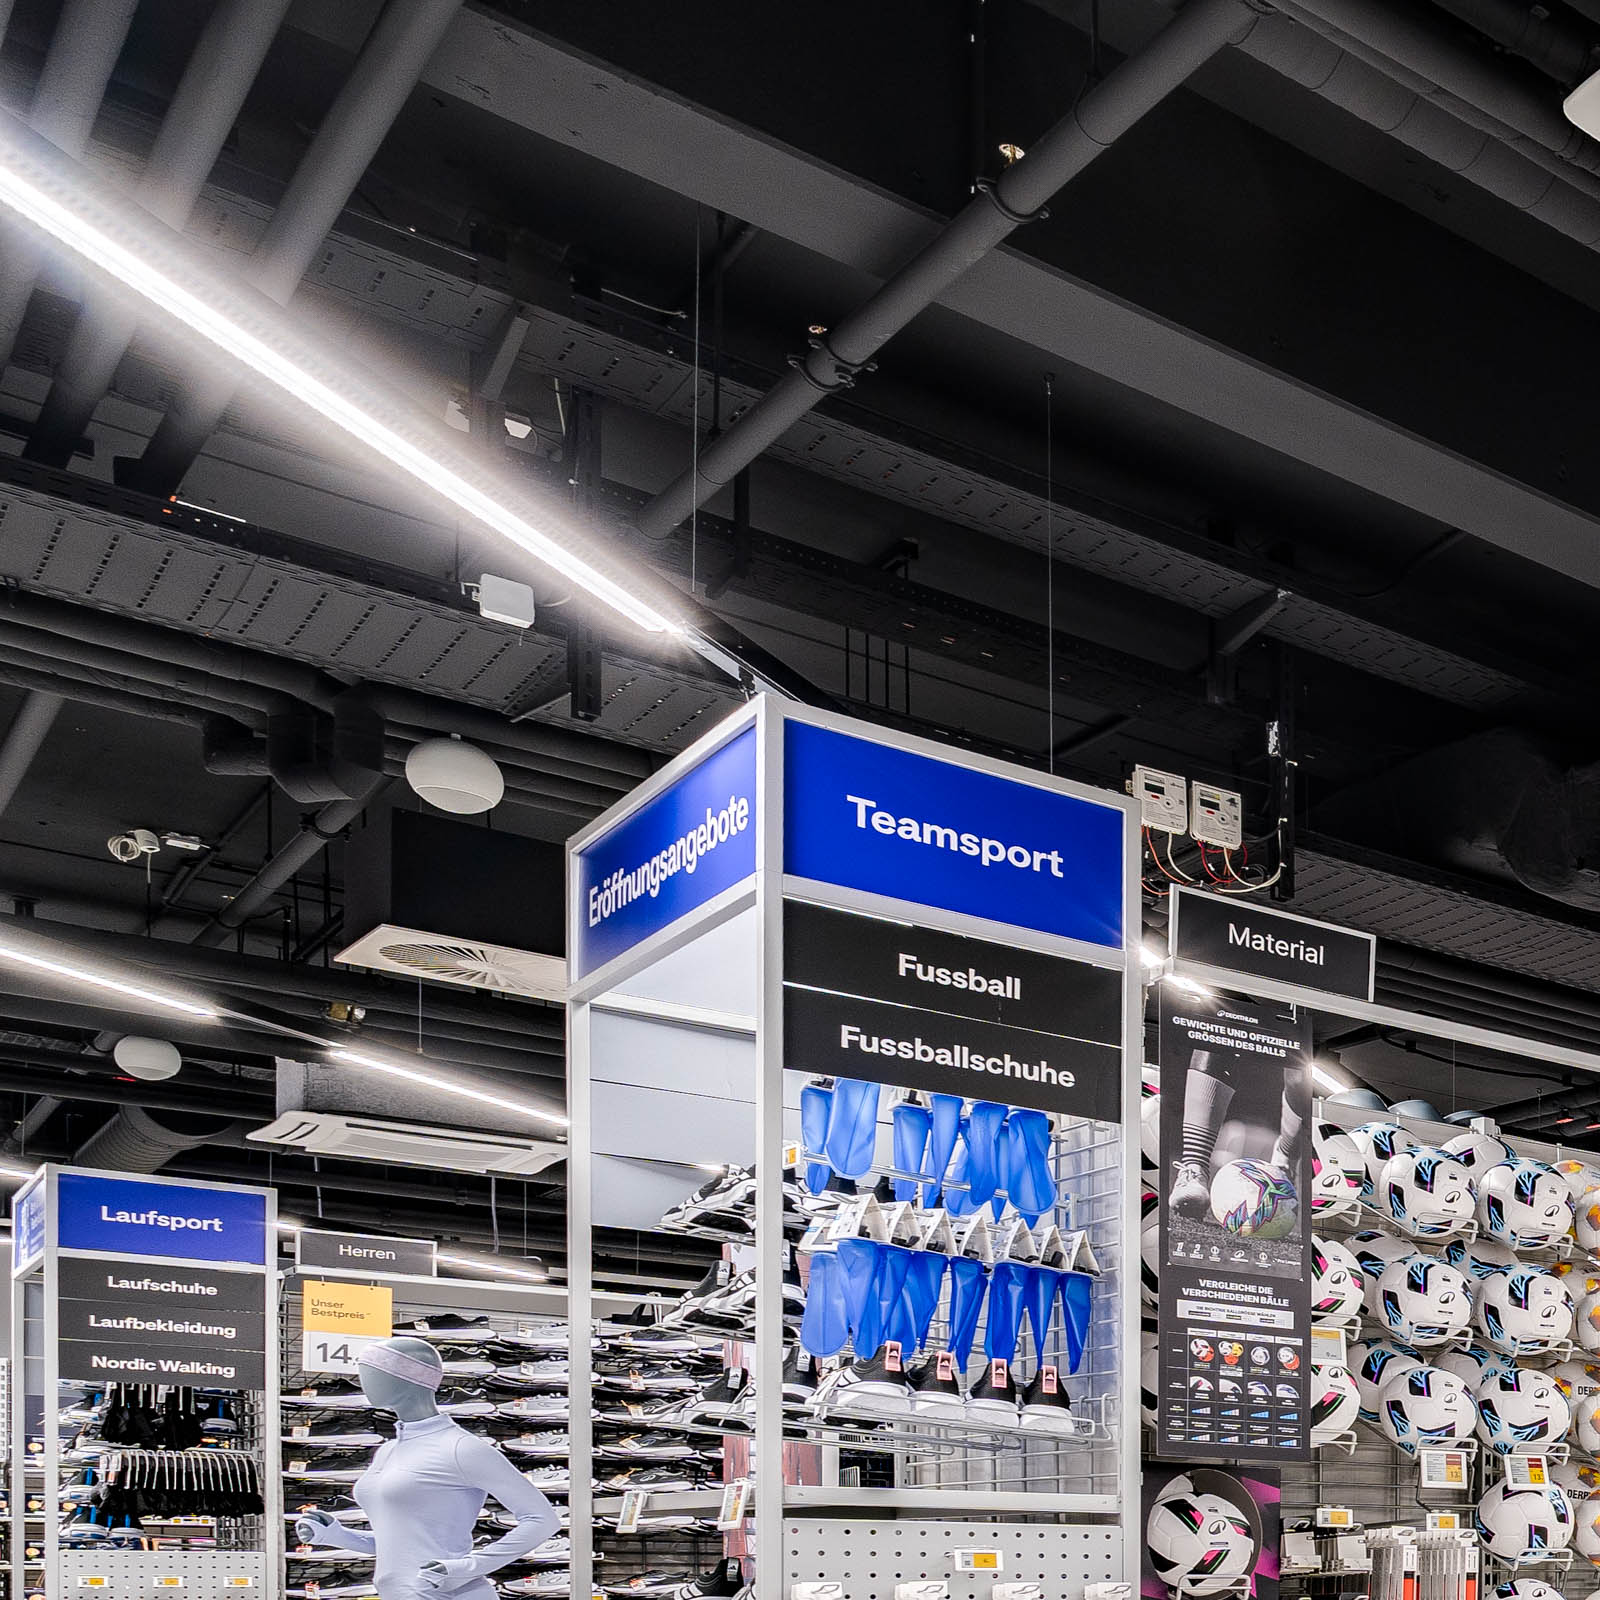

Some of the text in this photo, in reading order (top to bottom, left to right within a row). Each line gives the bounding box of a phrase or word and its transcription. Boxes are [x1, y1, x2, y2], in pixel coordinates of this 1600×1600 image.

[846, 794, 1064, 878] Teamsport
[588, 795, 748, 928] Eröffnungsangebote
[1228, 923, 1325, 965] Material
[899, 953, 1021, 1001] Fussball
[1172, 1016, 1300, 1050] GEWICHTE UND OFFIZIELLE
[1187, 1030, 1286, 1058] GRÖSSEN DES BALLS
[840, 1024, 1076, 1088] Fussballschuhe
[100, 1205, 223, 1232] Laufsport
[339, 1244, 396, 1260] Herren
[107, 1275, 218, 1296] Laufschuhe
[1182, 1287, 1290, 1307] VERSCHIEDENEN BÄLLE
[1198, 1279, 1274, 1295] VERGLEICHE DIE
[311, 1298, 344, 1309] Unser
[311, 1308, 365, 1320] Bestpreis
[88, 1314, 237, 1339] Laufbekleidung
[91, 1355, 236, 1379] Nordic Walking
